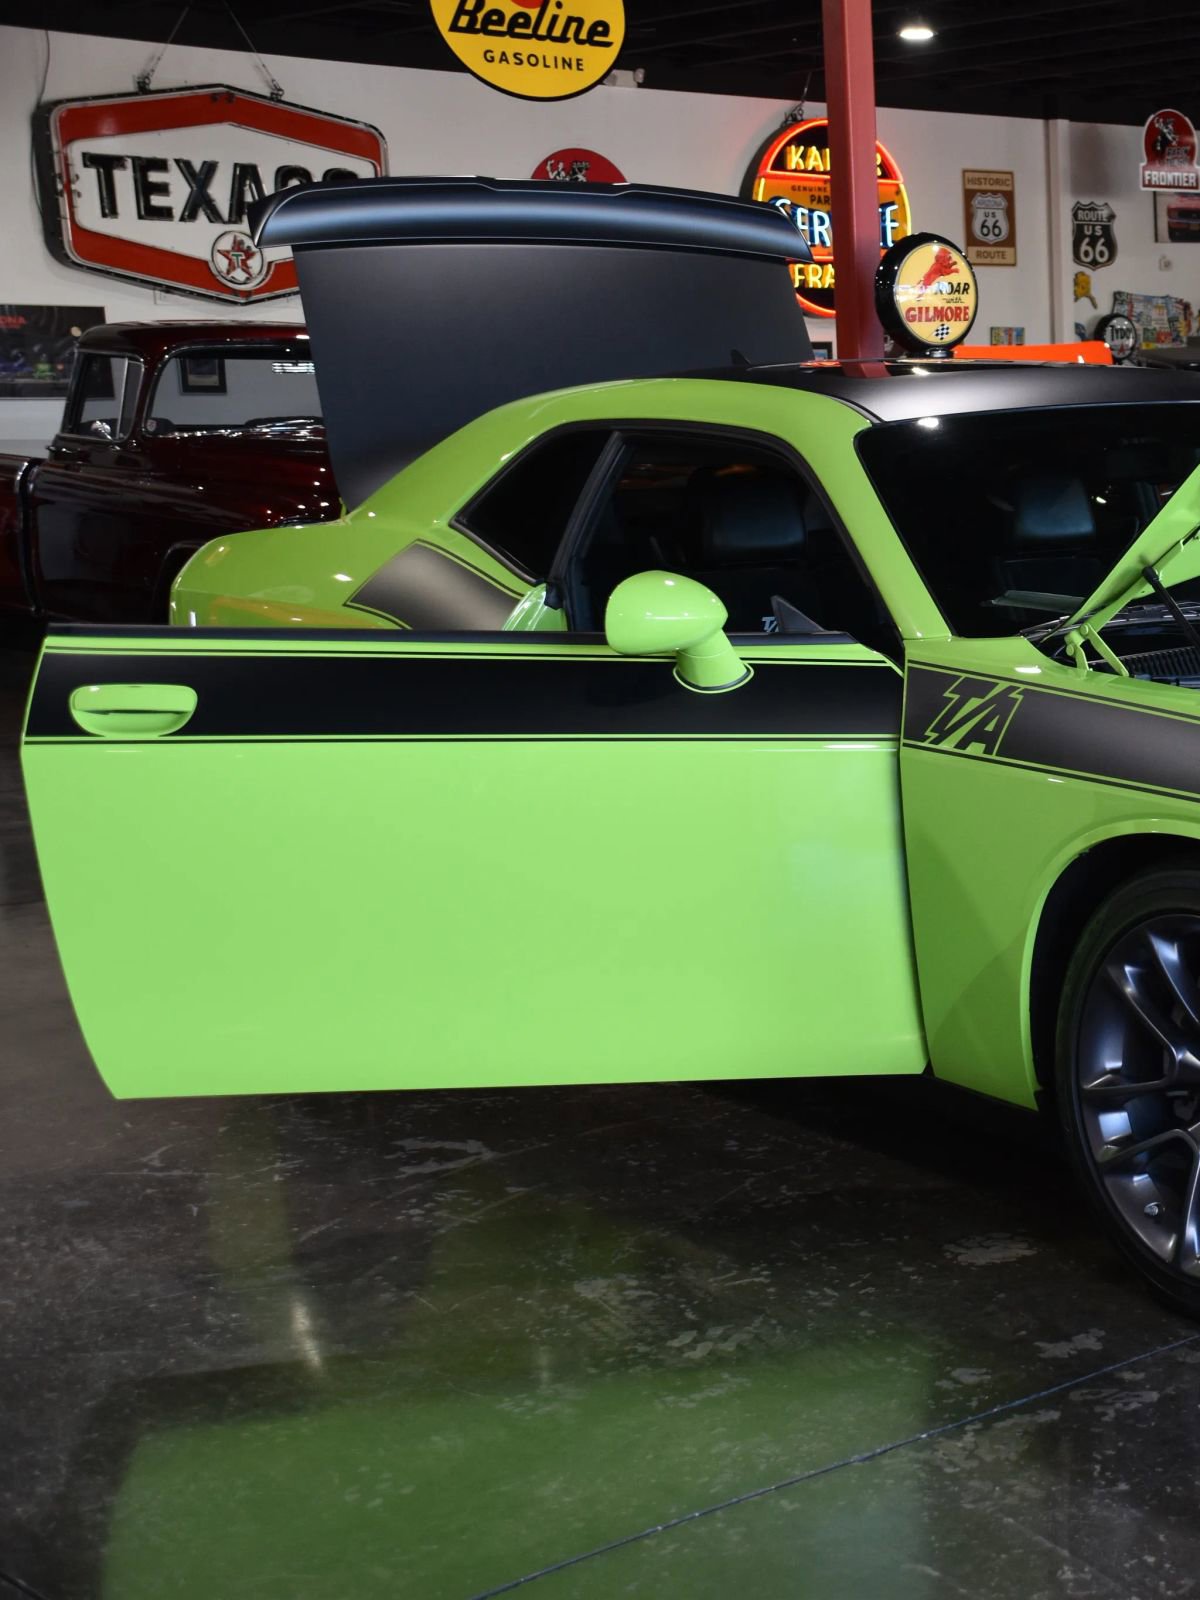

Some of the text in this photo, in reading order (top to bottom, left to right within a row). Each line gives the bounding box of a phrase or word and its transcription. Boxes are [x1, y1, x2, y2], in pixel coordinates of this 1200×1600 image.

[448, 0, 613, 48] Beeline
[484, 50, 585, 72] GASOLINE
[967, 176, 1011, 187] HISTORIC
[1144, 171, 1197, 187] FRONTIER
[82, 152, 359, 224] TEXA
[791, 184, 828, 193] GENUINE
[980, 218, 1002, 238] 66
[1083, 224, 1103, 236] US
[976, 249, 1008, 260] ROUTE
[1079, 237, 1109, 263] 66
[905, 306, 970, 323] GILMORE
